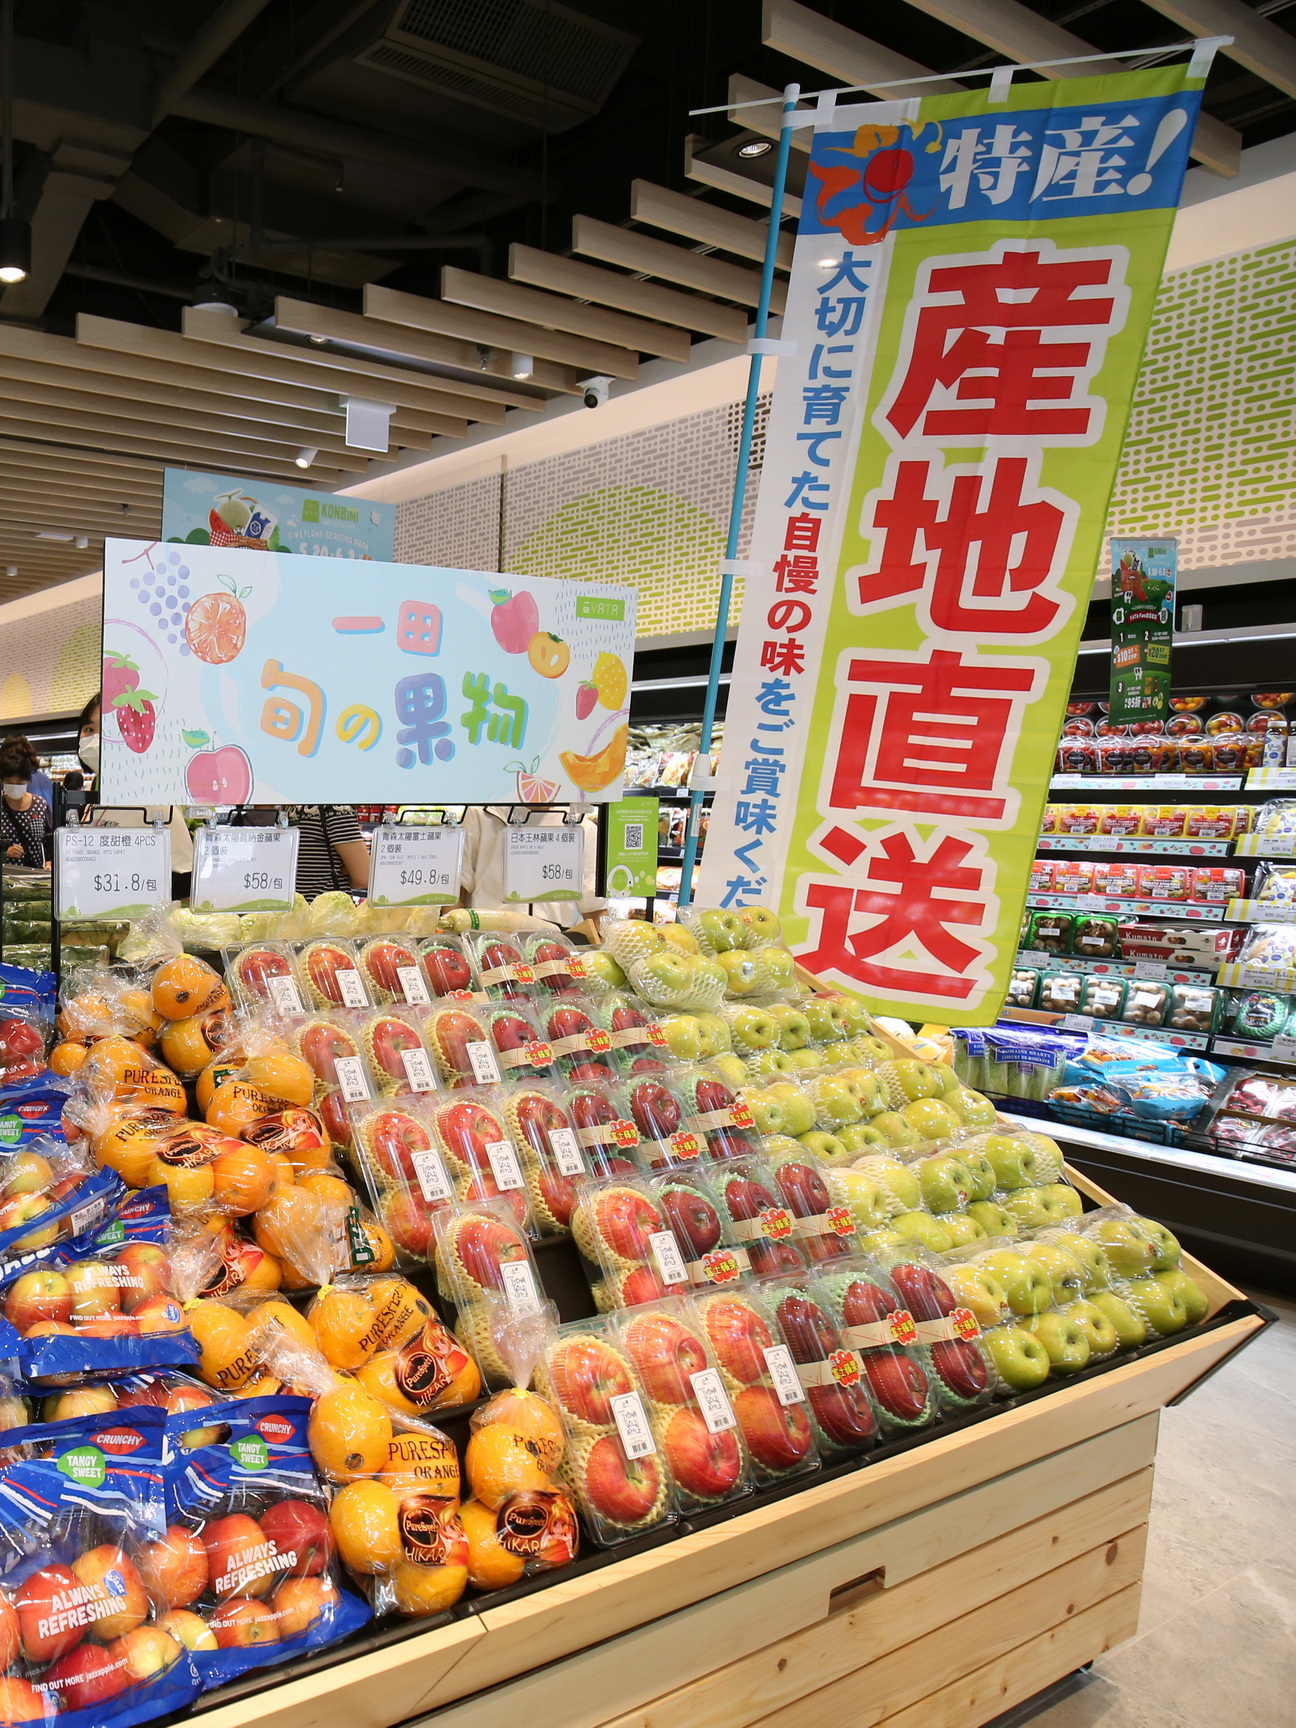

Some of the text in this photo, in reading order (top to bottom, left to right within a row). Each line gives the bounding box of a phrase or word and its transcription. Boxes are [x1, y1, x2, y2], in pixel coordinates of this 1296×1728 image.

[938, 106, 1188, 210] 特産!
[322, 503, 359, 522] KONBINI
[354, 538, 369, 551] PARK
[592, 602, 619, 618] YATA
[331, 599, 444, 657] 一田
[796, 251, 1115, 999] 産地直送
[1120, 633, 1123, 642] 1
[1145, 631, 1148, 640] 2
[1118, 683, 1122, 692] 3
[259, 658, 529, 770] 旬の果物
[65, 835, 156, 847] PS-12 度甜橙 4PCS
[511, 833, 554, 843] 日本王林蘋果
[381, 844, 402, 853] 2 個裝
[400, 869, 449, 885] $49.8/包
[542, 865, 573, 880] $58/包
[94, 874, 157, 892] $31.8/包
[244, 873, 283, 890] $58/包
[1126, 932, 1157, 942] Kumato
[1129, 949, 1163, 960] Kumato
[0, 1128, 20, 1136] SWEET
[761, 1218, 791, 1234] 富士蘋果
[704, 1259, 738, 1279] 富士蘋果
[73, 1277, 144, 1294] REFRESHING
[890, 1321, 916, 1338] 富士蘋果
[406, 1356, 433, 1387] PureSpect
[832, 1361, 858, 1380] 富士蘋果
[259, 1421, 292, 1436] CRUNCHY
[96, 1434, 143, 1446] CRUNCHY
[237, 1441, 261, 1455] TANGY
[66, 1456, 97, 1468] TANGY
[240, 1453, 265, 1465] SWEET
[72, 1467, 102, 1478] SWEET
[414, 1465, 460, 1479] ORANGE
[227, 1540, 278, 1572] ALWAYS
[215, 1551, 298, 1594] REFRESHING
[51, 1583, 99, 1614] ALWAYS
[37, 1595, 127, 1640] REFRESHING
[223, 1608, 294, 1628] OUT MORE jazzapple.com
[31, 1658, 128, 1694] FIND OUT MORE jazzapple.com
